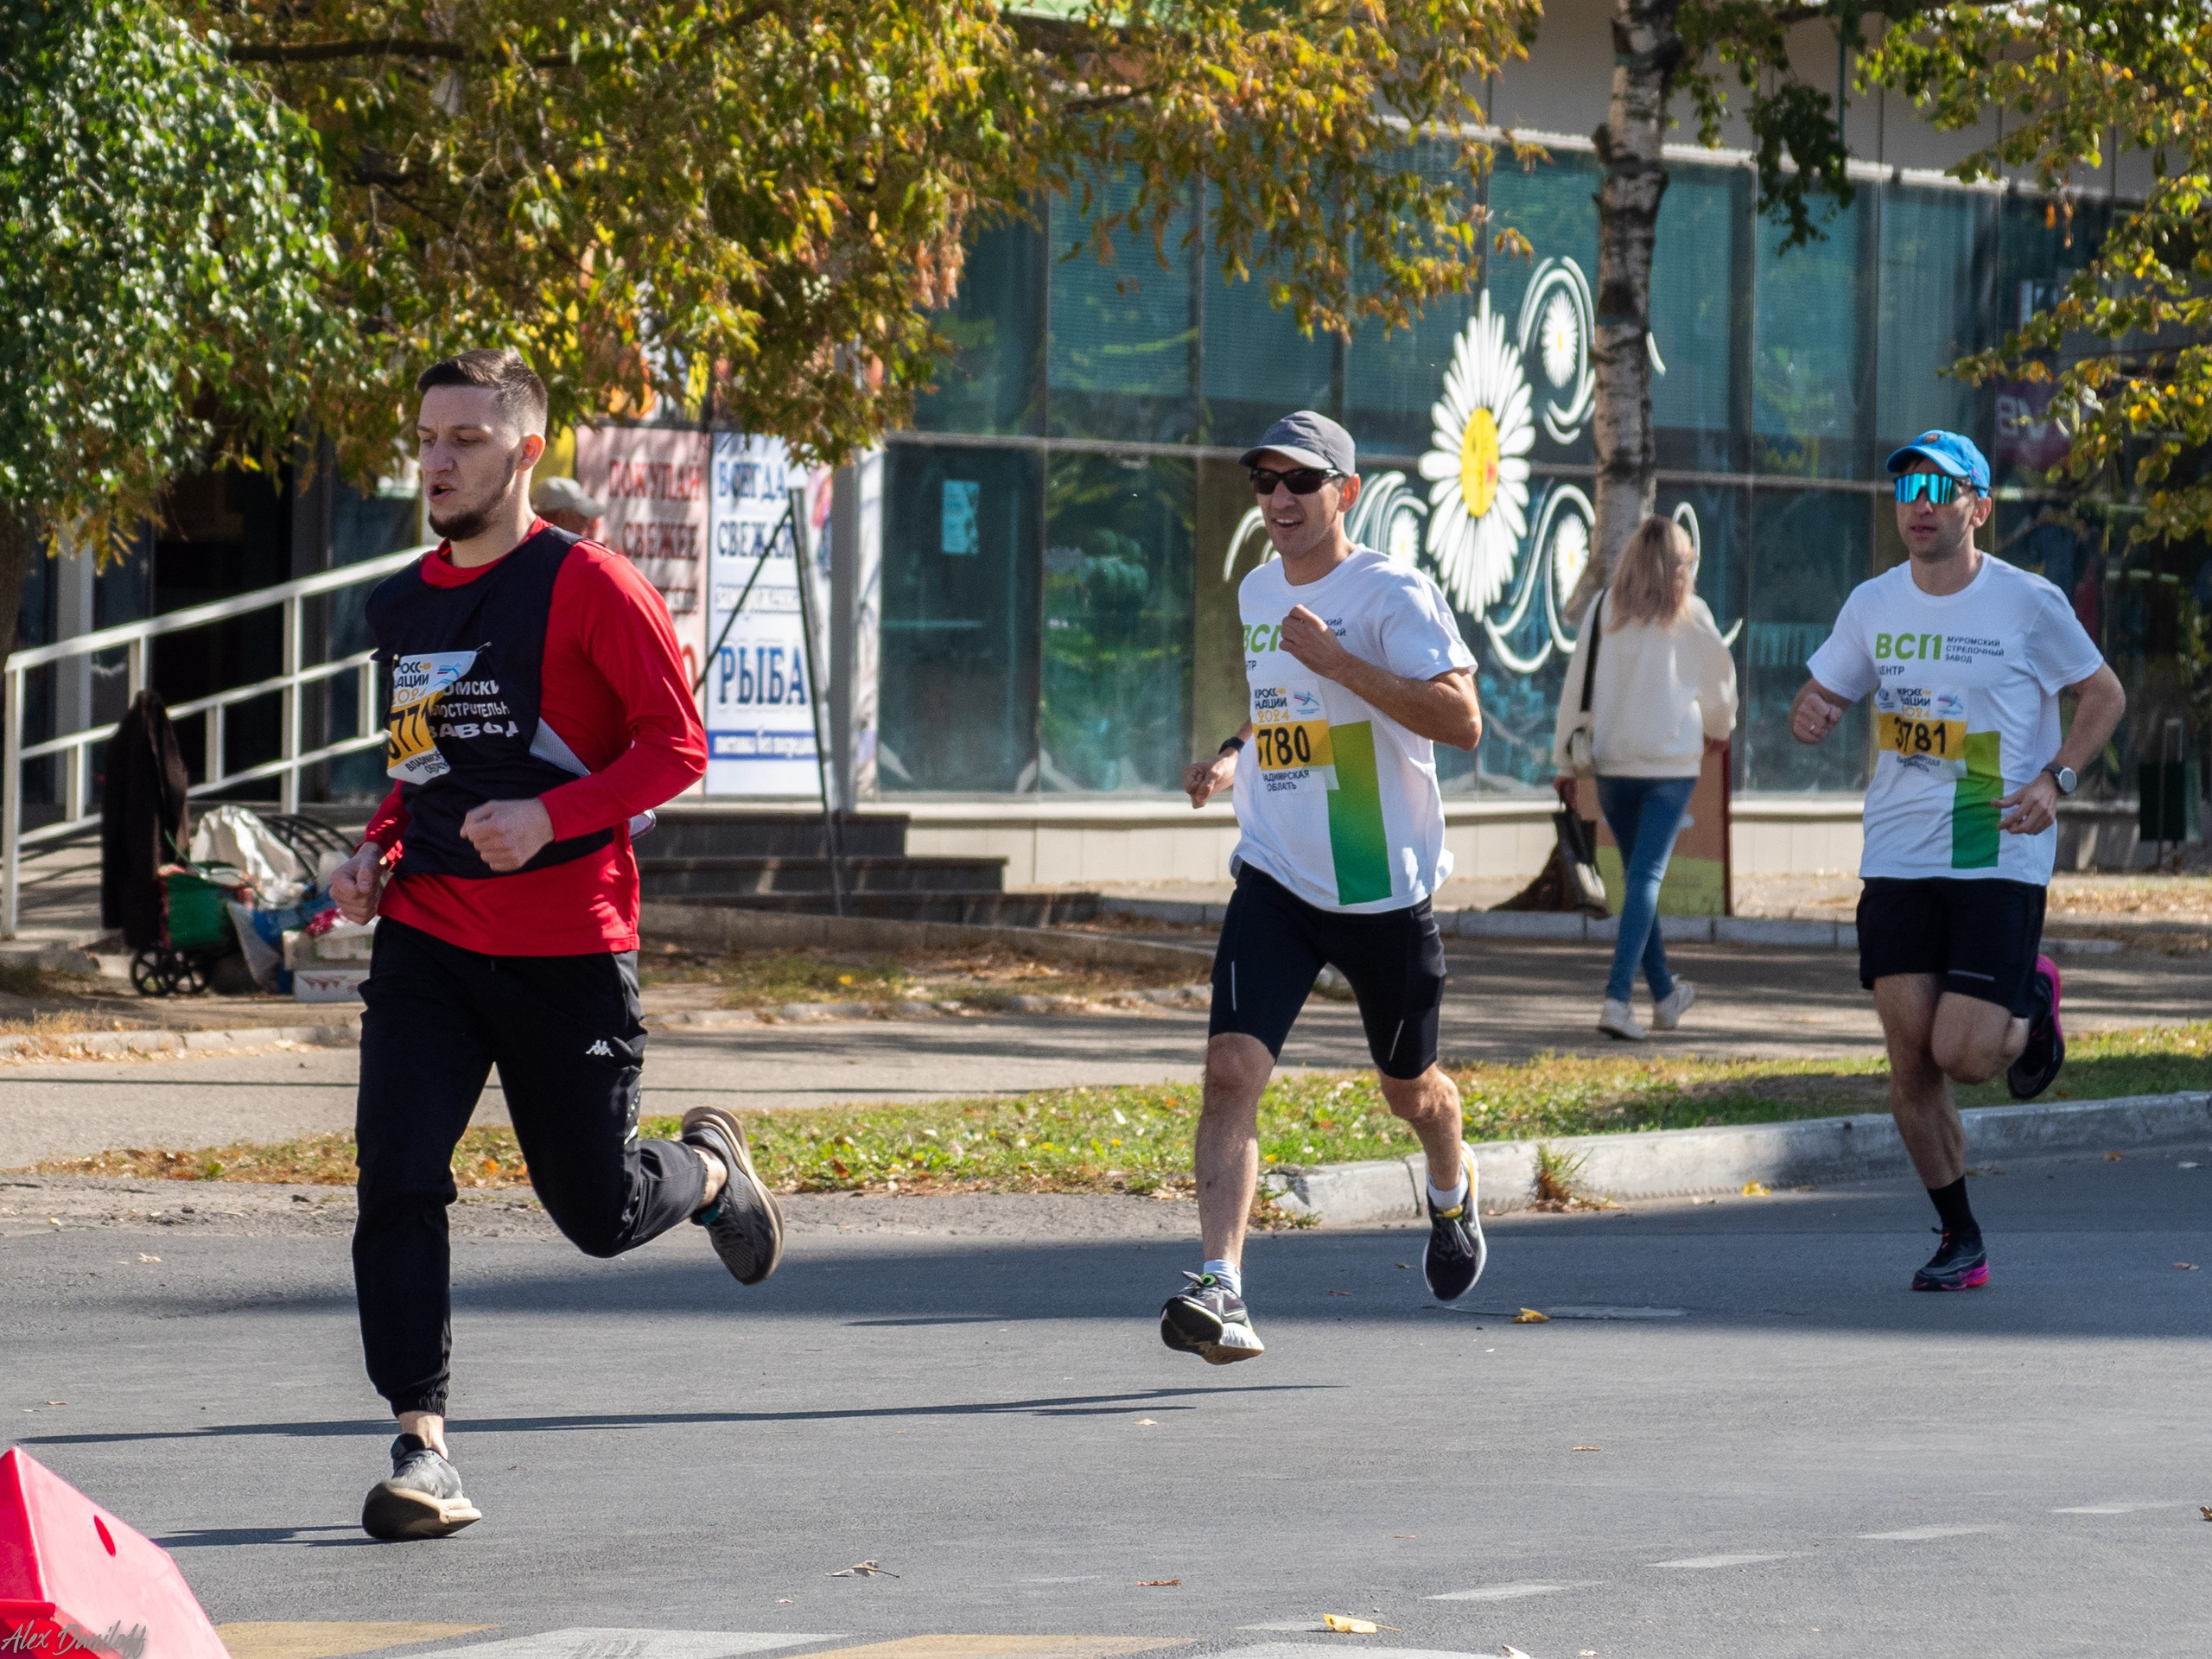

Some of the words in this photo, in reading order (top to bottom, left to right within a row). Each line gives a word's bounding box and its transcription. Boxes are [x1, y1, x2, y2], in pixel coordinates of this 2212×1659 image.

[719, 461, 786, 501] ВСЕГДА
[622, 521, 699, 560] СВЕЖЕЕ
[717, 520, 793, 559] СВЕЖАЯ
[1875, 632, 1942, 660] ВСП
[1947, 635, 2000, 647] МУРОМСКИЙ
[1945, 653, 1973, 664] ЗАВОД
[1946, 645, 2005, 657] СТРЕЛОЧНЫЙ
[400, 661, 421, 674] ОСС
[718, 645, 807, 705] РЫБА
[1878, 665, 1905, 676] ЕНТР
[394, 673, 429, 689] АЦИИ
